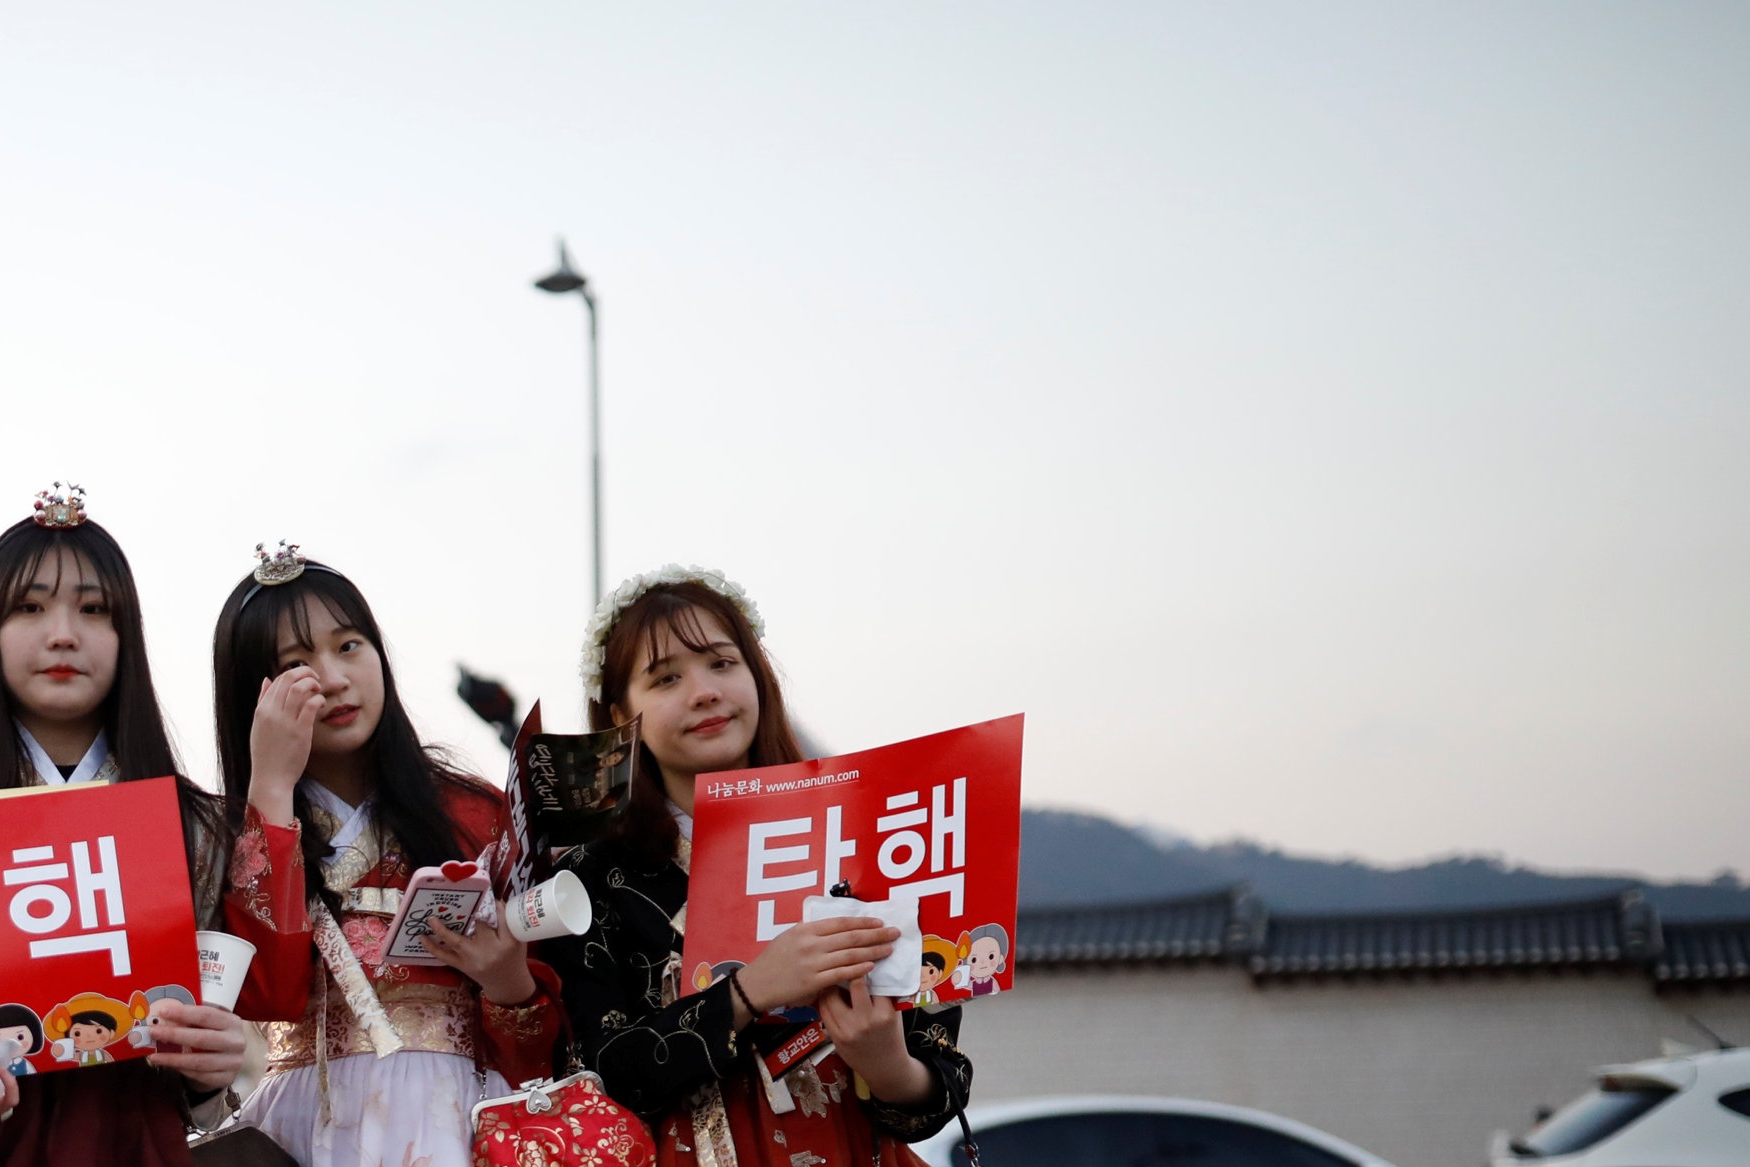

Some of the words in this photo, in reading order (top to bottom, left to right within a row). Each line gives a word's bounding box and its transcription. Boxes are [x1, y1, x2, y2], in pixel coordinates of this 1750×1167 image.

[708, 778, 762, 799] 나눔문화
[765, 769, 860, 793] www.nanum.com
[745, 777, 967, 942] 탄핵
[199, 949, 220, 961] 근혜
[777, 1027, 820, 1064] 황교안은
